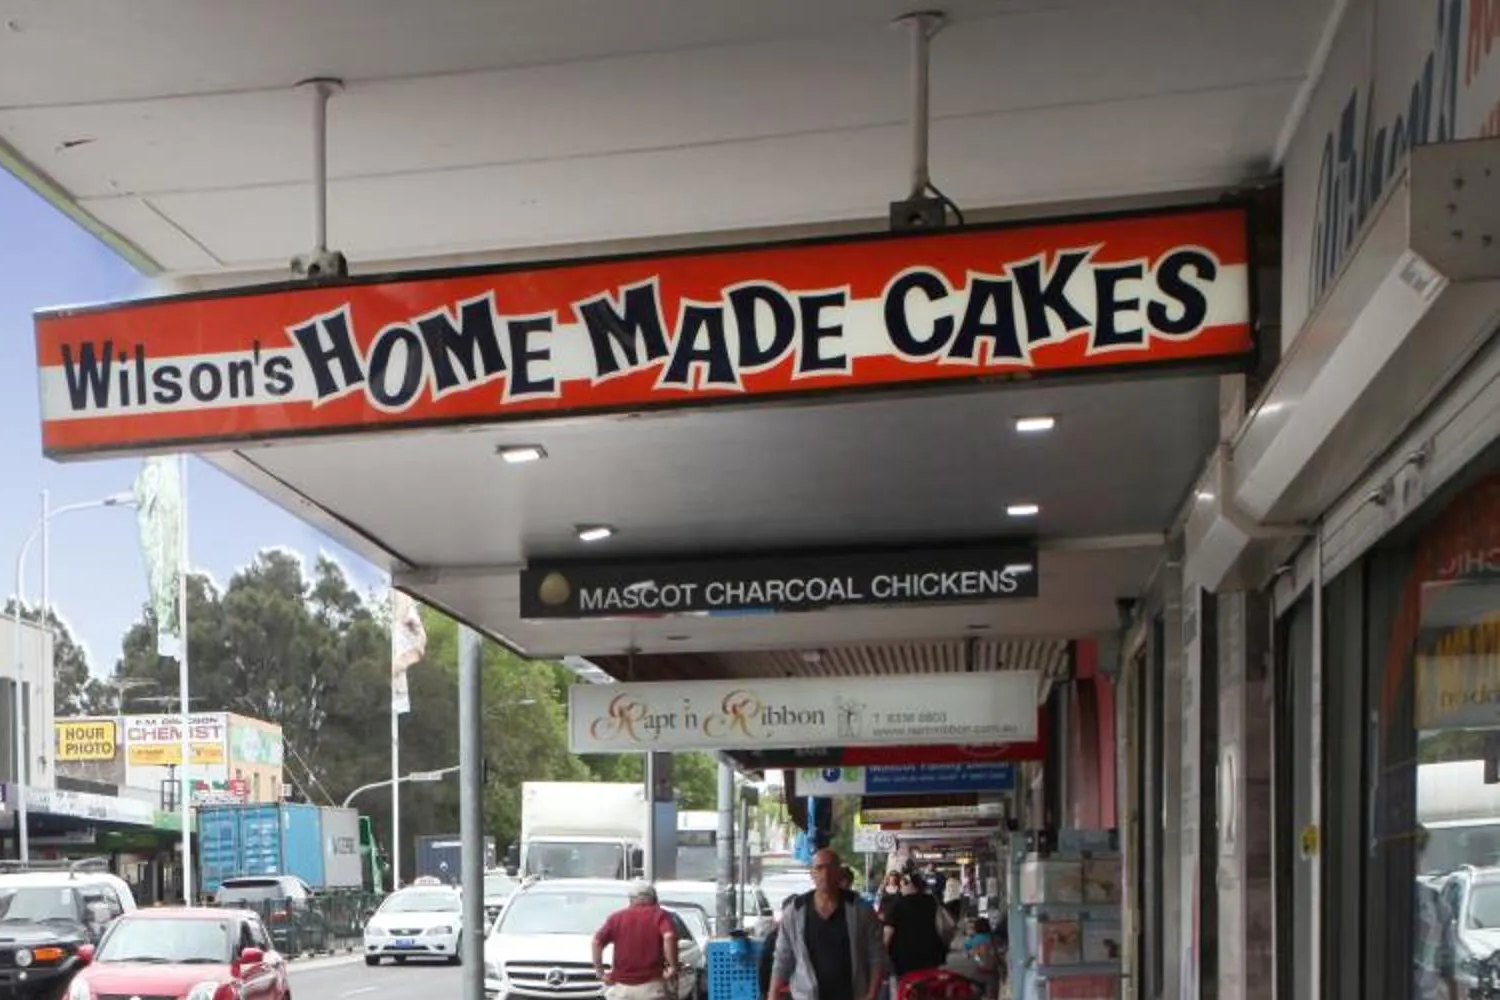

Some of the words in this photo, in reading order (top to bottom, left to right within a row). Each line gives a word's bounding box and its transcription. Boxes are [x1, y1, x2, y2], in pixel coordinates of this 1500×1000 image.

[61, 339, 294, 411] Wilson's
[293, 297, 555, 407] HOME
[579, 283, 847, 384] MADE
[884, 250, 1216, 357] CAKES
[579, 584, 696, 610] MASCOT
[705, 575, 861, 605] CHARCOAL
[871, 569, 1018, 599] CHICKENS
[65, 727, 105, 740] HOUR
[127, 724, 223, 742] CHEMIST
[65, 741, 113, 756] PHOTO
